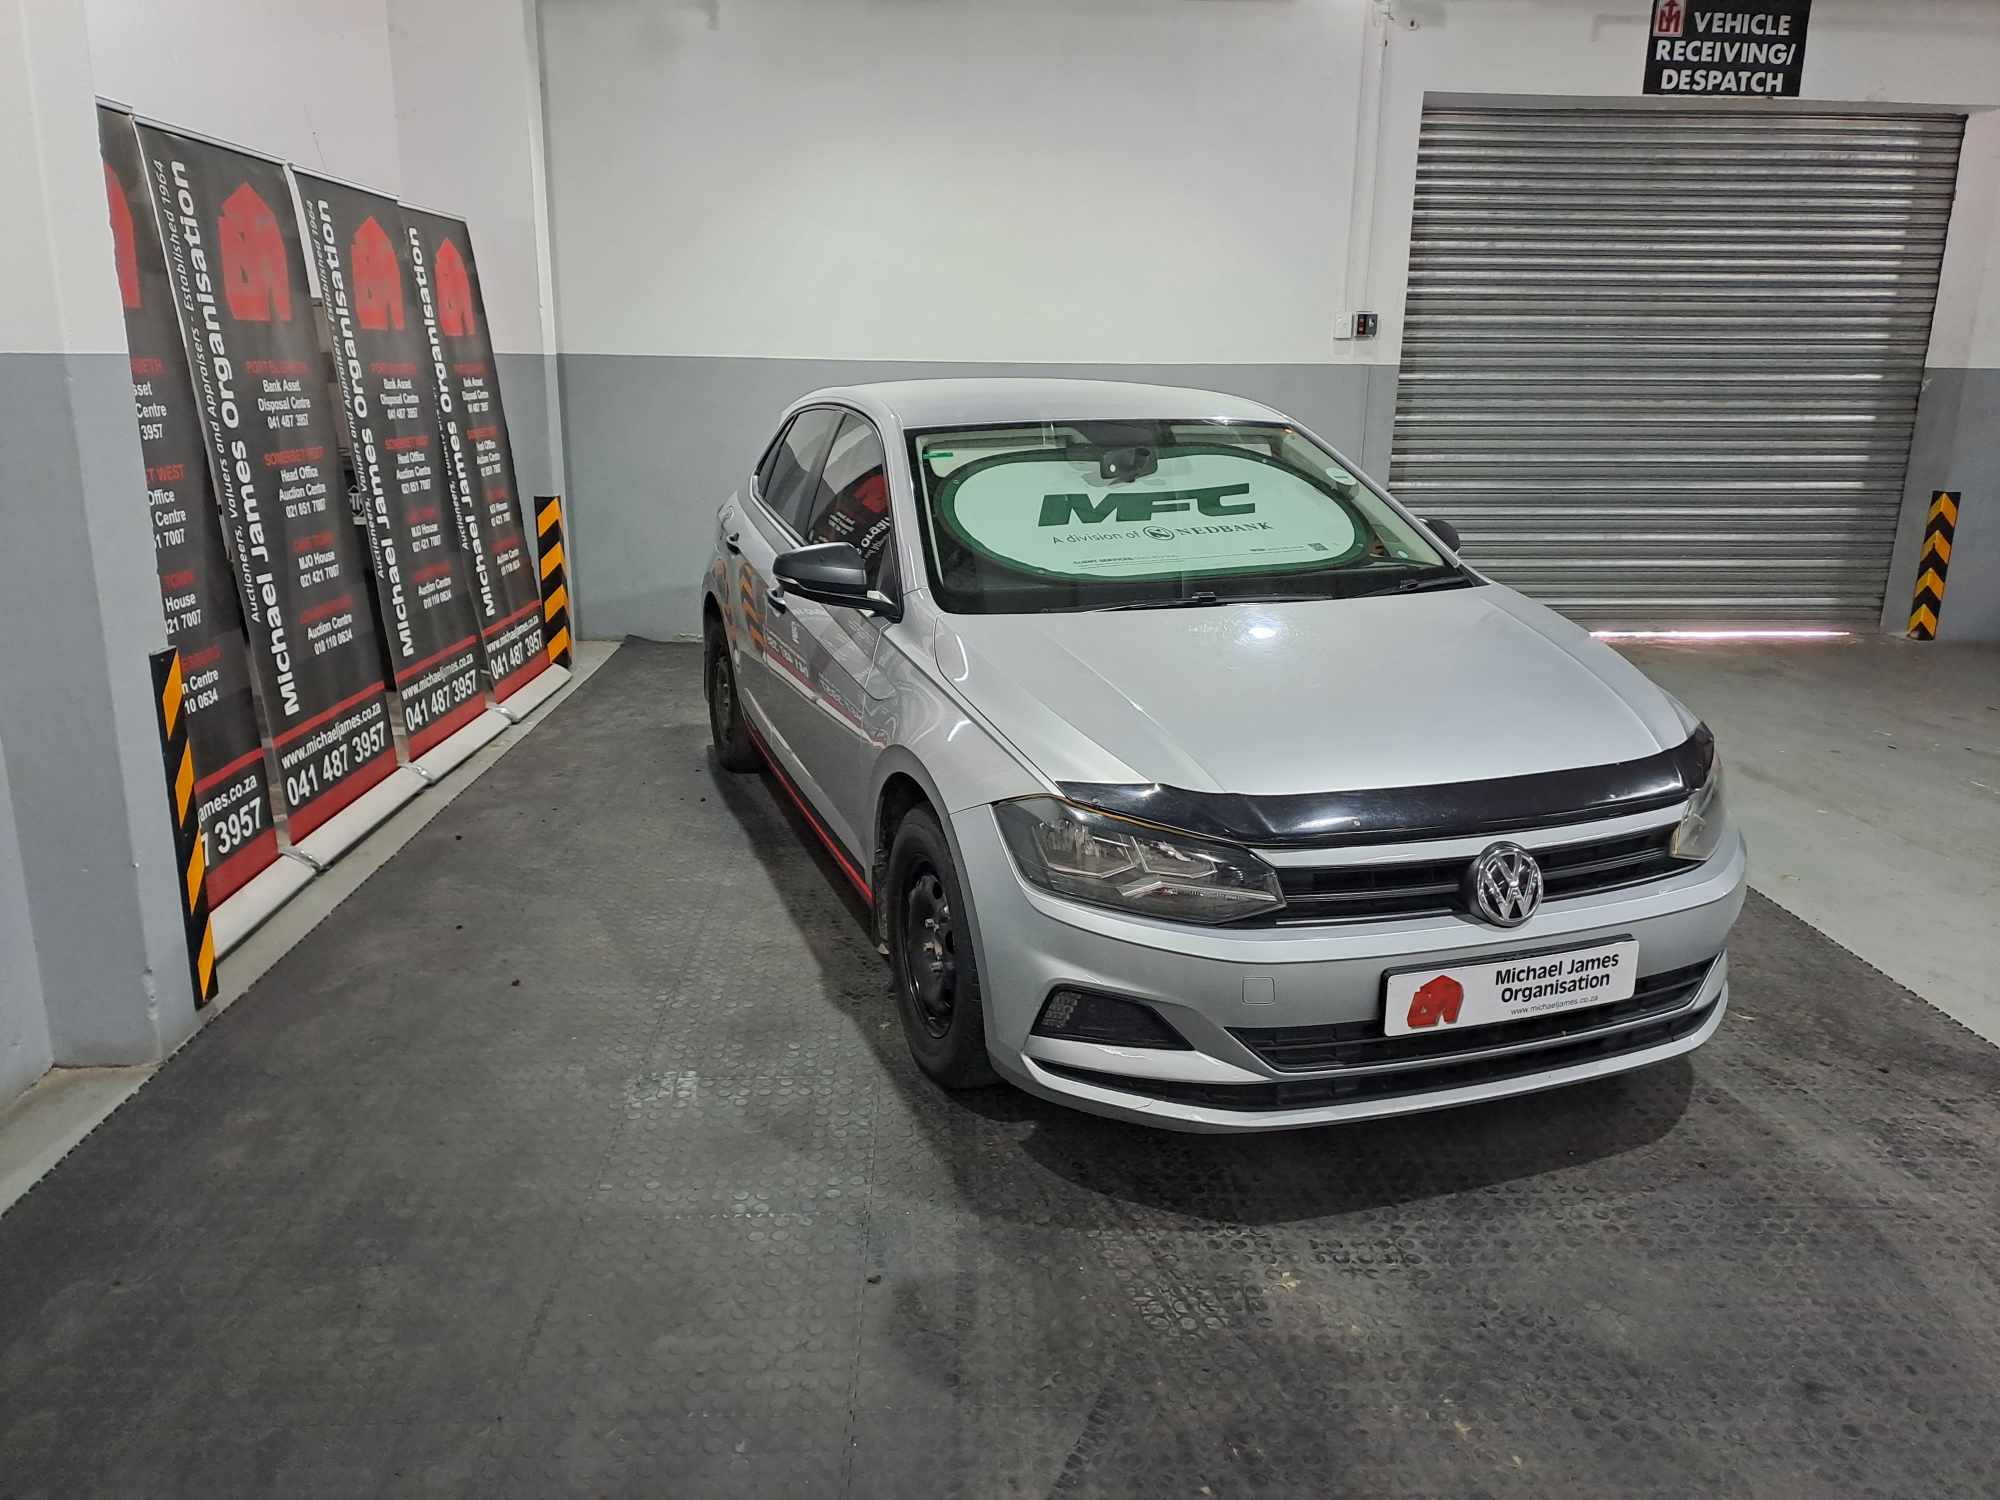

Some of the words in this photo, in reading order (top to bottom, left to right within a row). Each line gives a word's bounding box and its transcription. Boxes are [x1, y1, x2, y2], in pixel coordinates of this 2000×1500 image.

[1694, 11, 1792, 36] VEHICLE
[1655, 40, 1796, 65] RECEIVING/
[1660, 68, 1784, 93] DESPATCH
[152, 159, 172, 204] 1964
[163, 208, 195, 312] Established
[170, 160, 240, 429] Organisation
[317, 199, 368, 419] Organisation
[408, 227, 452, 413] Organisation
[191, 326, 217, 417] Appraisers
[262, 379, 282, 393] Bank
[131, 381, 153, 397] sset
[257, 397, 290, 414] Disposal
[135, 402, 167, 418] Centre
[140, 423, 163, 440] 3957
[209, 420, 225, 454] and
[299, 466, 319, 480] Office
[361, 427, 390, 529] James
[446, 421, 473, 509] James
[147, 488, 175, 506] Office
[219, 457, 239, 519] Valuers
[231, 439, 269, 563] James
[279, 486, 305, 502] Auction
[1038, 482, 1256, 527] MFC
[155, 508, 187, 527] Centre
[1052, 535, 1064, 545] A
[1065, 530, 1122, 544] division
[1126, 529, 1141, 540] of
[1175, 521, 1274, 537] NEDBANK
[163, 528, 185, 548] 7007
[235, 524, 262, 623] Auctioneers,
[313, 551, 335, 566] House
[464, 515, 496, 617] Michael
[165, 592, 197, 613] House
[380, 537, 415, 657] Michael
[181, 609, 202, 629] 7007
[307, 622, 332, 640] Auction
[331, 613, 352, 630] Centre
[256, 572, 300, 717] Michael
[490, 651, 509, 680] 041
[509, 641, 524, 667] 487
[524, 628, 543, 657] 3957
[190, 668, 220, 692] Centre
[401, 653, 474, 701] www.michaeljames.co.za
[183, 696, 197, 716] 10
[198, 686, 219, 709] 0634
[405, 698, 429, 732] 041
[431, 684, 450, 715] 487
[451, 669, 477, 702] 3957
[281, 702, 382, 770] www.michaeljames.co.za
[286, 763, 319, 807] 041
[322, 743, 349, 781] 487
[351, 720, 386, 764] 3957
[214, 796, 262, 855] 3957
[1495, 960, 1562, 986] Michael
[1567, 953, 1620, 975] James
[1501, 972, 1610, 1003] Organisation
